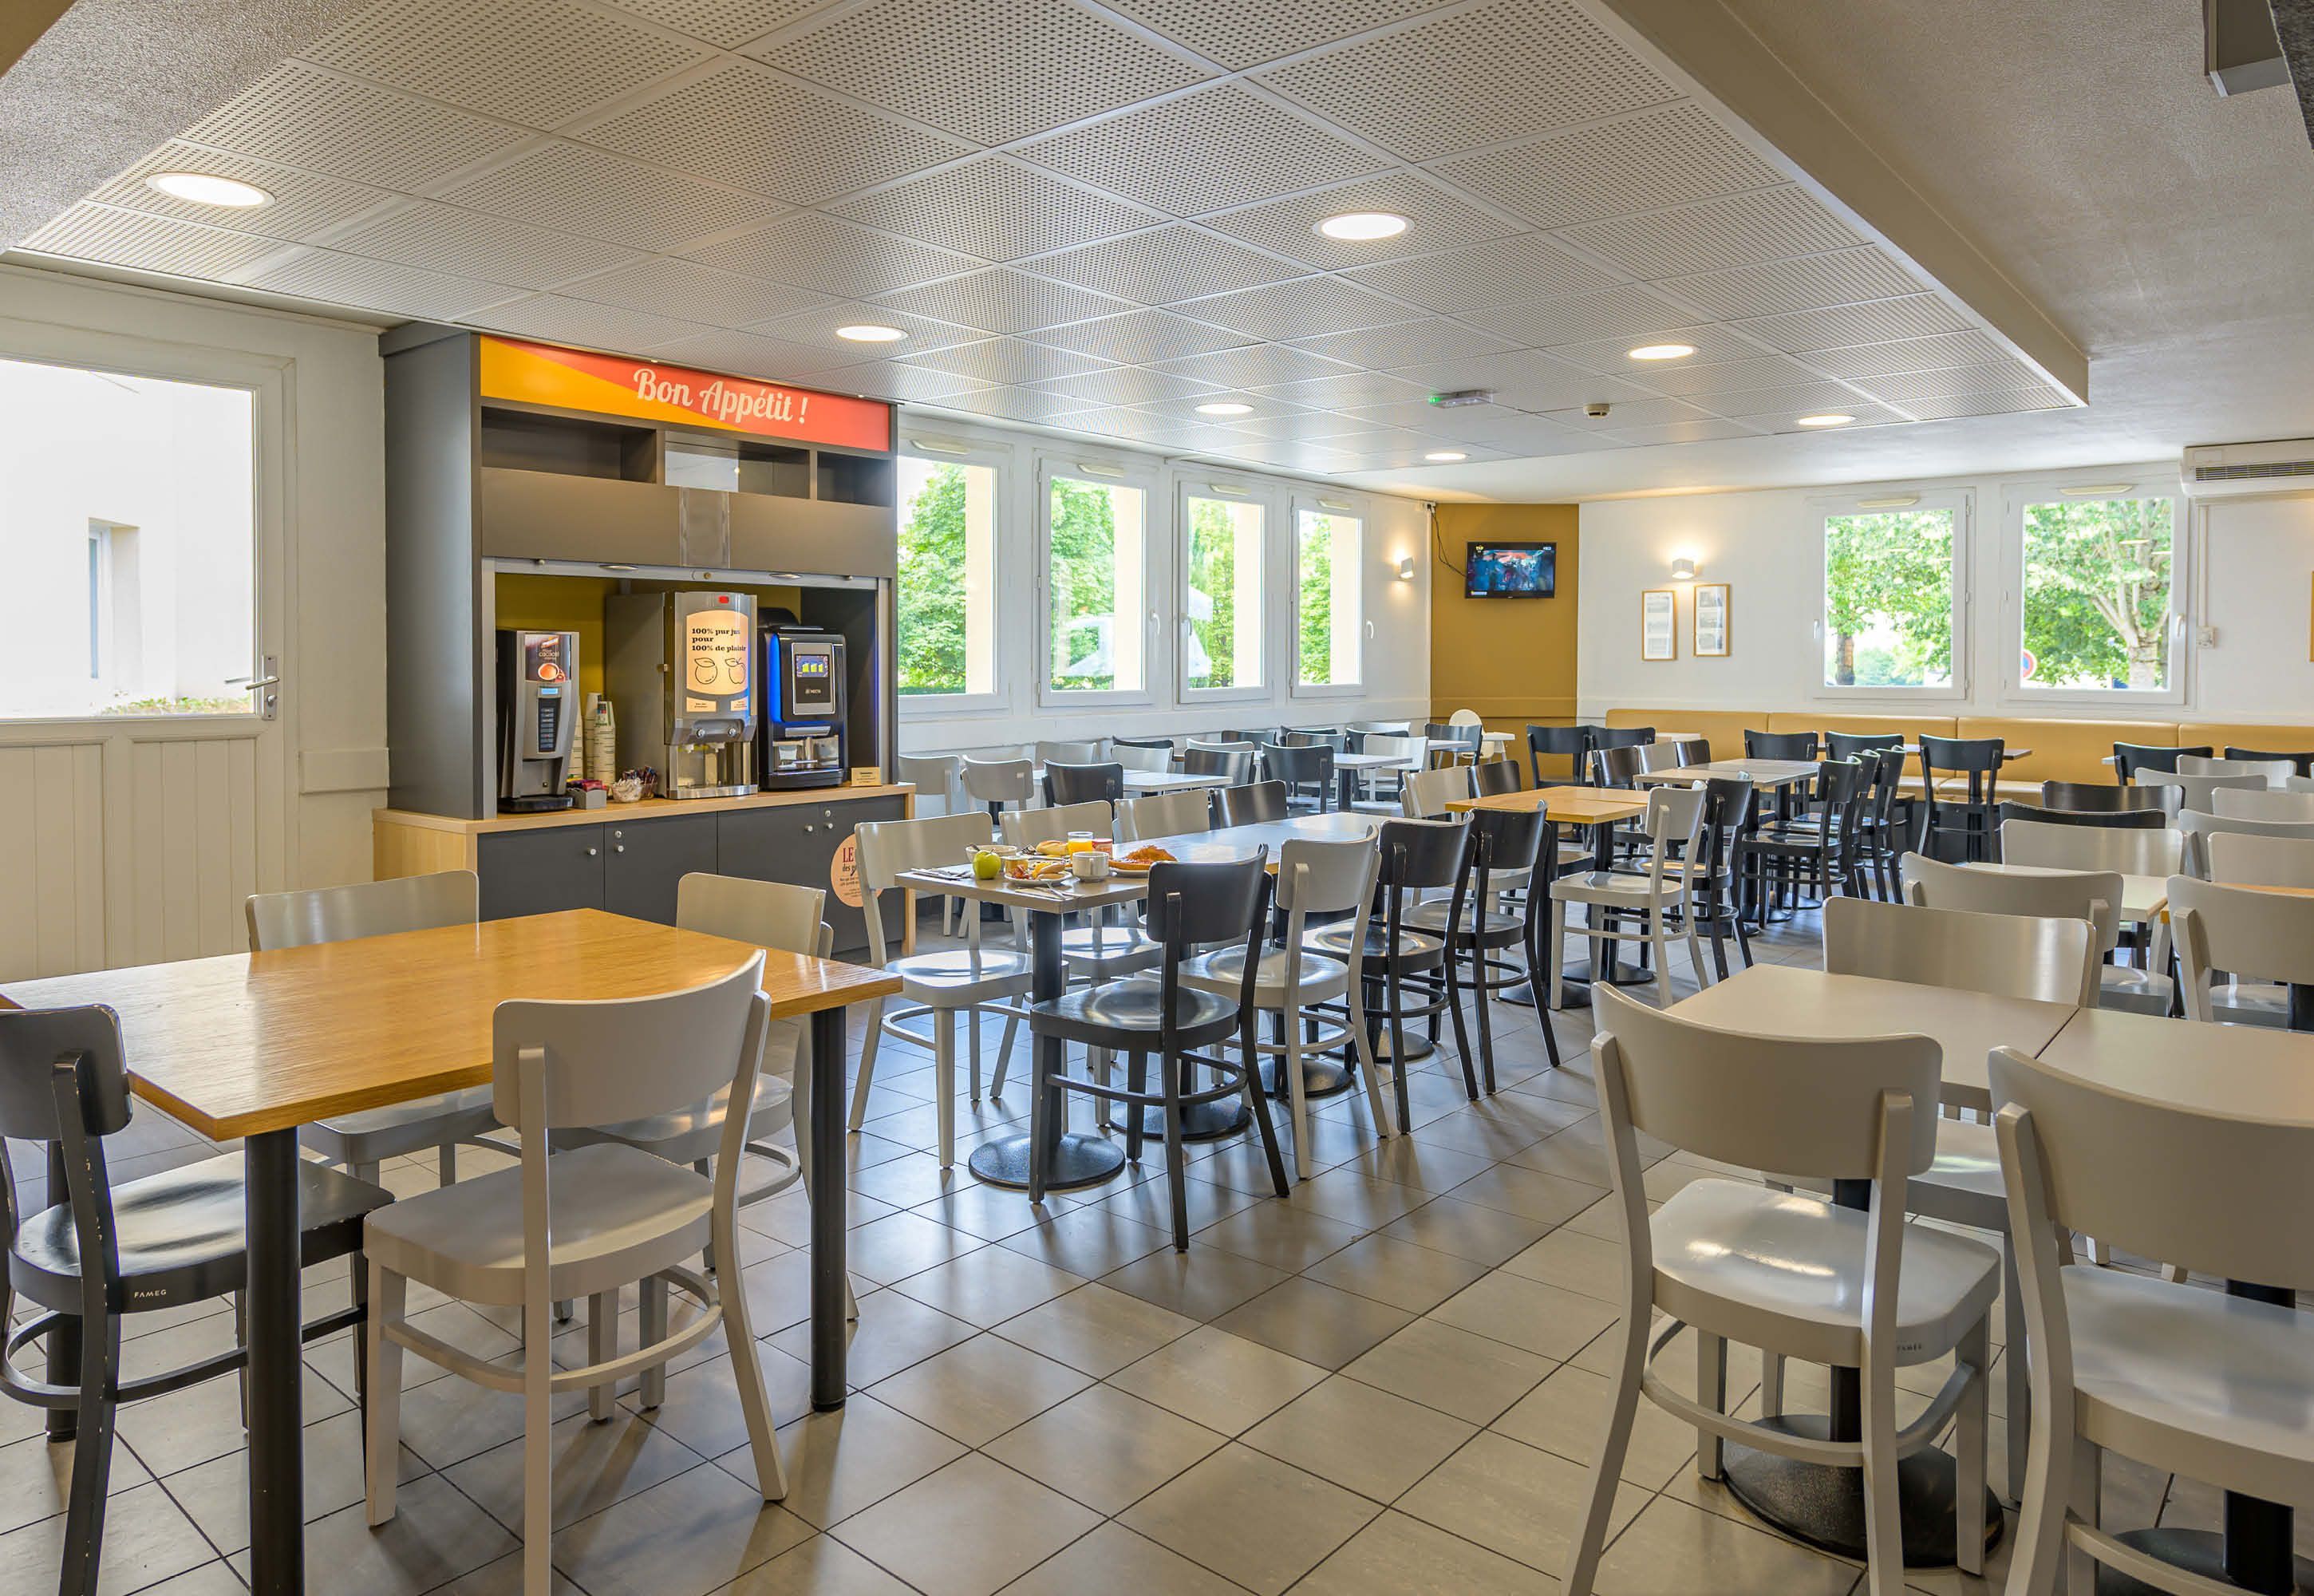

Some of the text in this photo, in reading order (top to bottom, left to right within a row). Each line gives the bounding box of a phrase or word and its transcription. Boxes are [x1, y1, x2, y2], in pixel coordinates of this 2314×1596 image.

[633, 368, 808, 425] Bon Appétit !
[843, 847, 854, 863] LE
[134, 1289, 167, 1298] FAMEG
